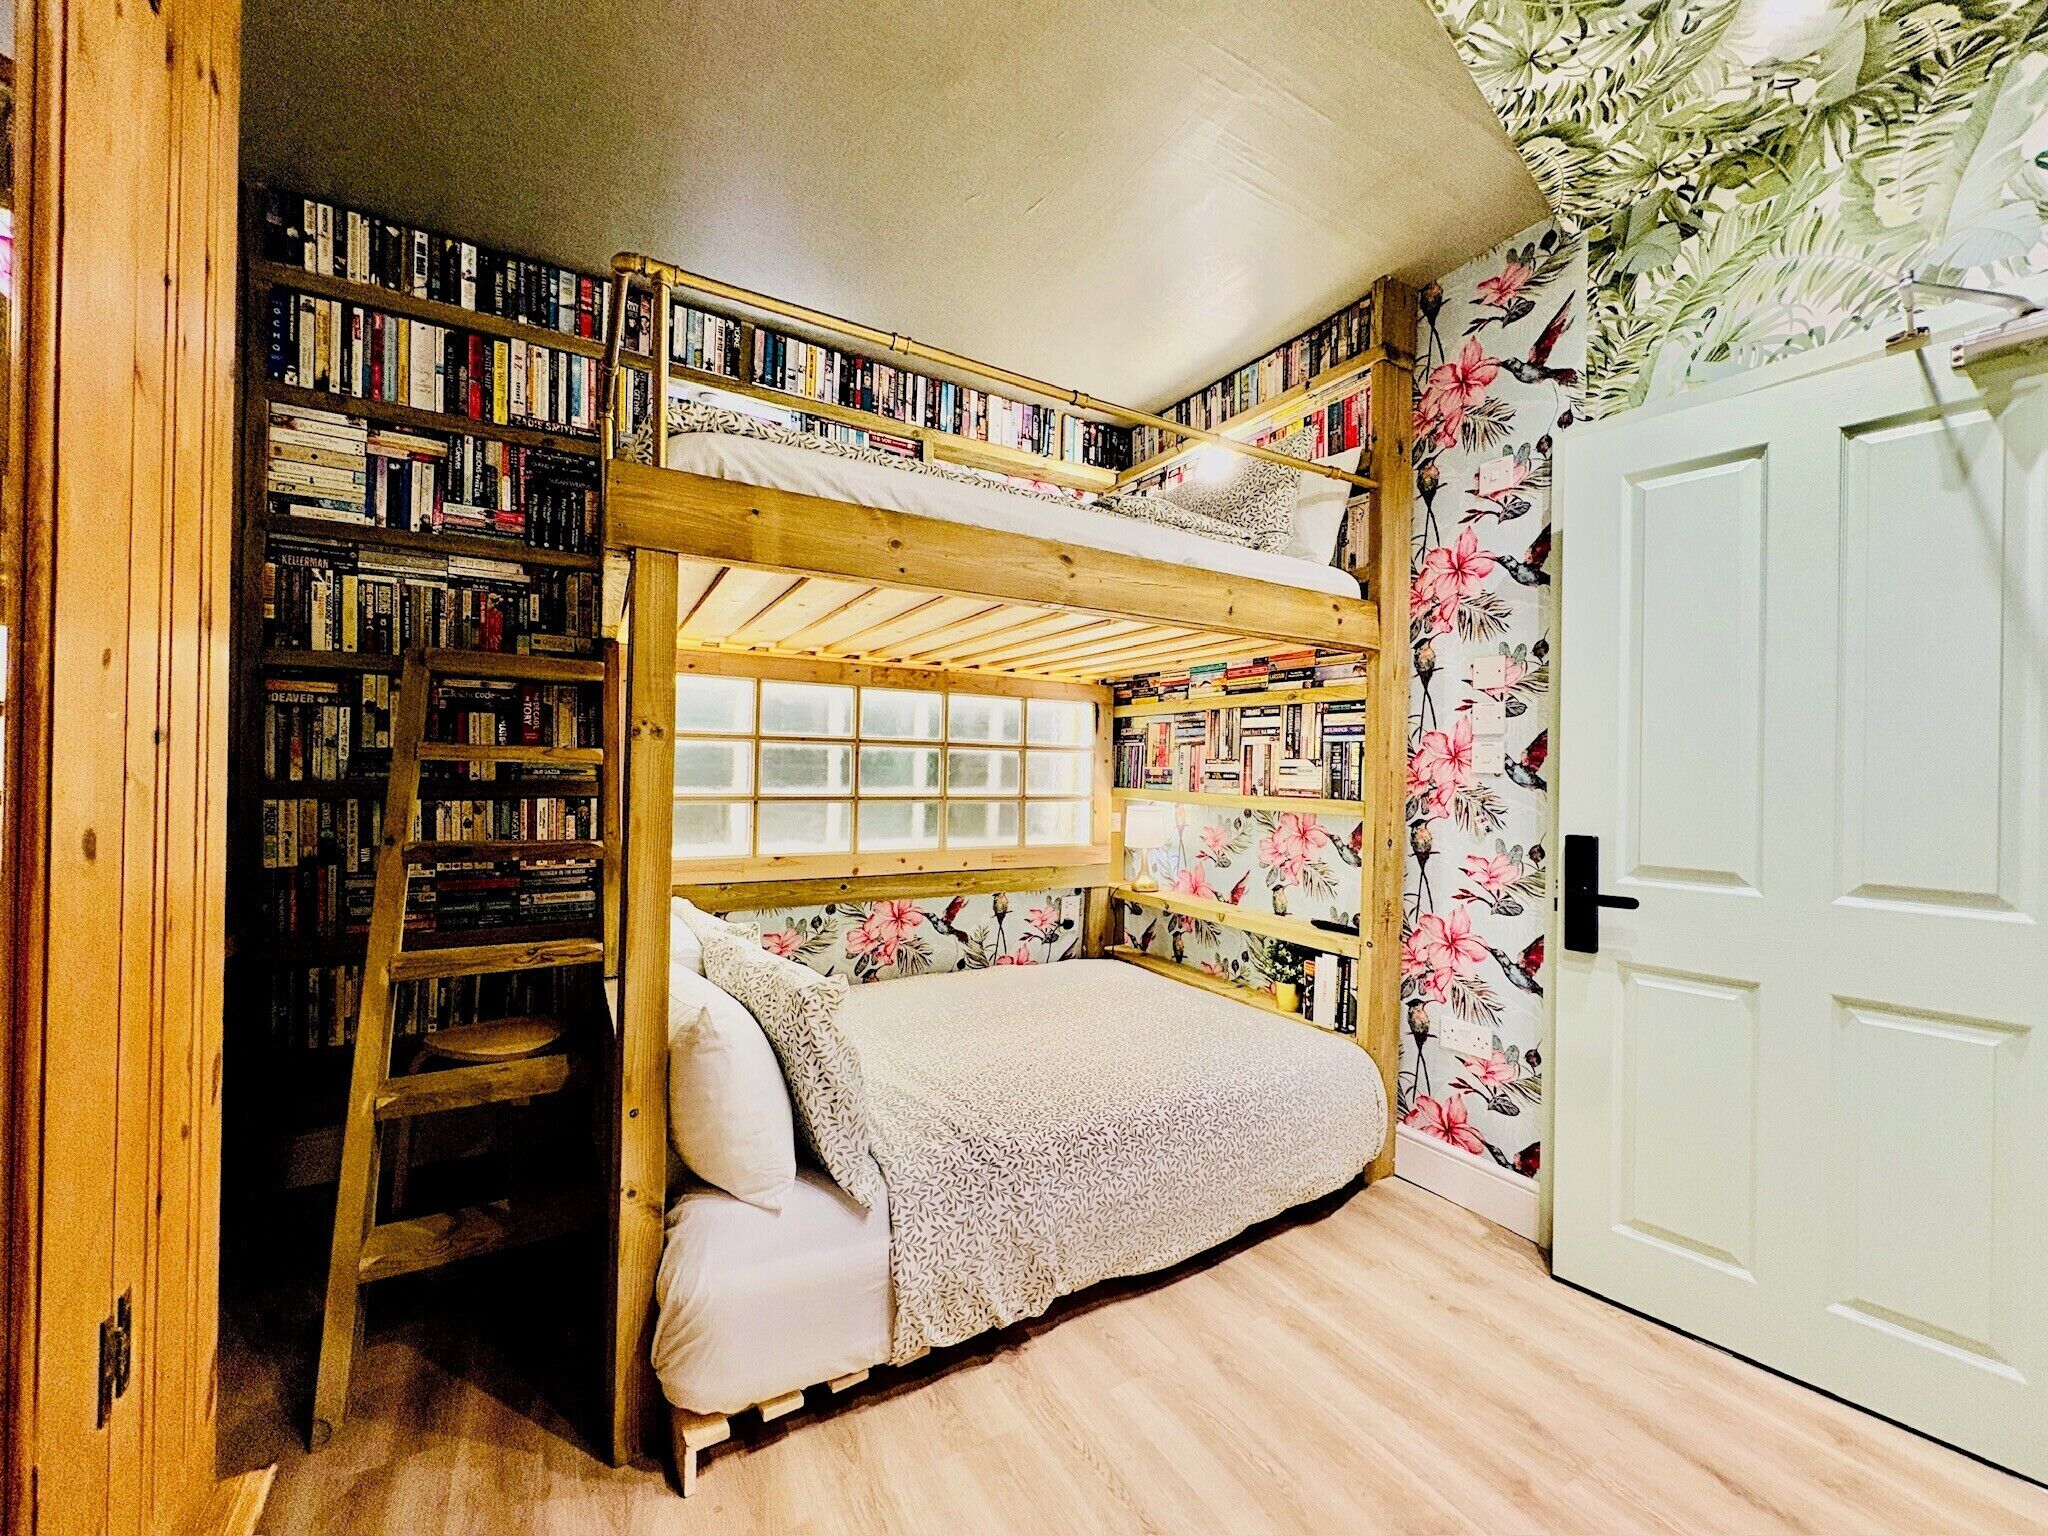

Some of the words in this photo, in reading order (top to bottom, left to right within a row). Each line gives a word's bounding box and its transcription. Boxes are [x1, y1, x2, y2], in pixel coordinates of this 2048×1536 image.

[515, 415, 545, 430] ZADIE
[545, 422, 577, 436] SMITH
[281, 553, 329, 569] KELLERMAN
[271, 692, 315, 704] DEAVER
[523, 701, 532, 726] TORY
[532, 701, 540, 730] DECADE
